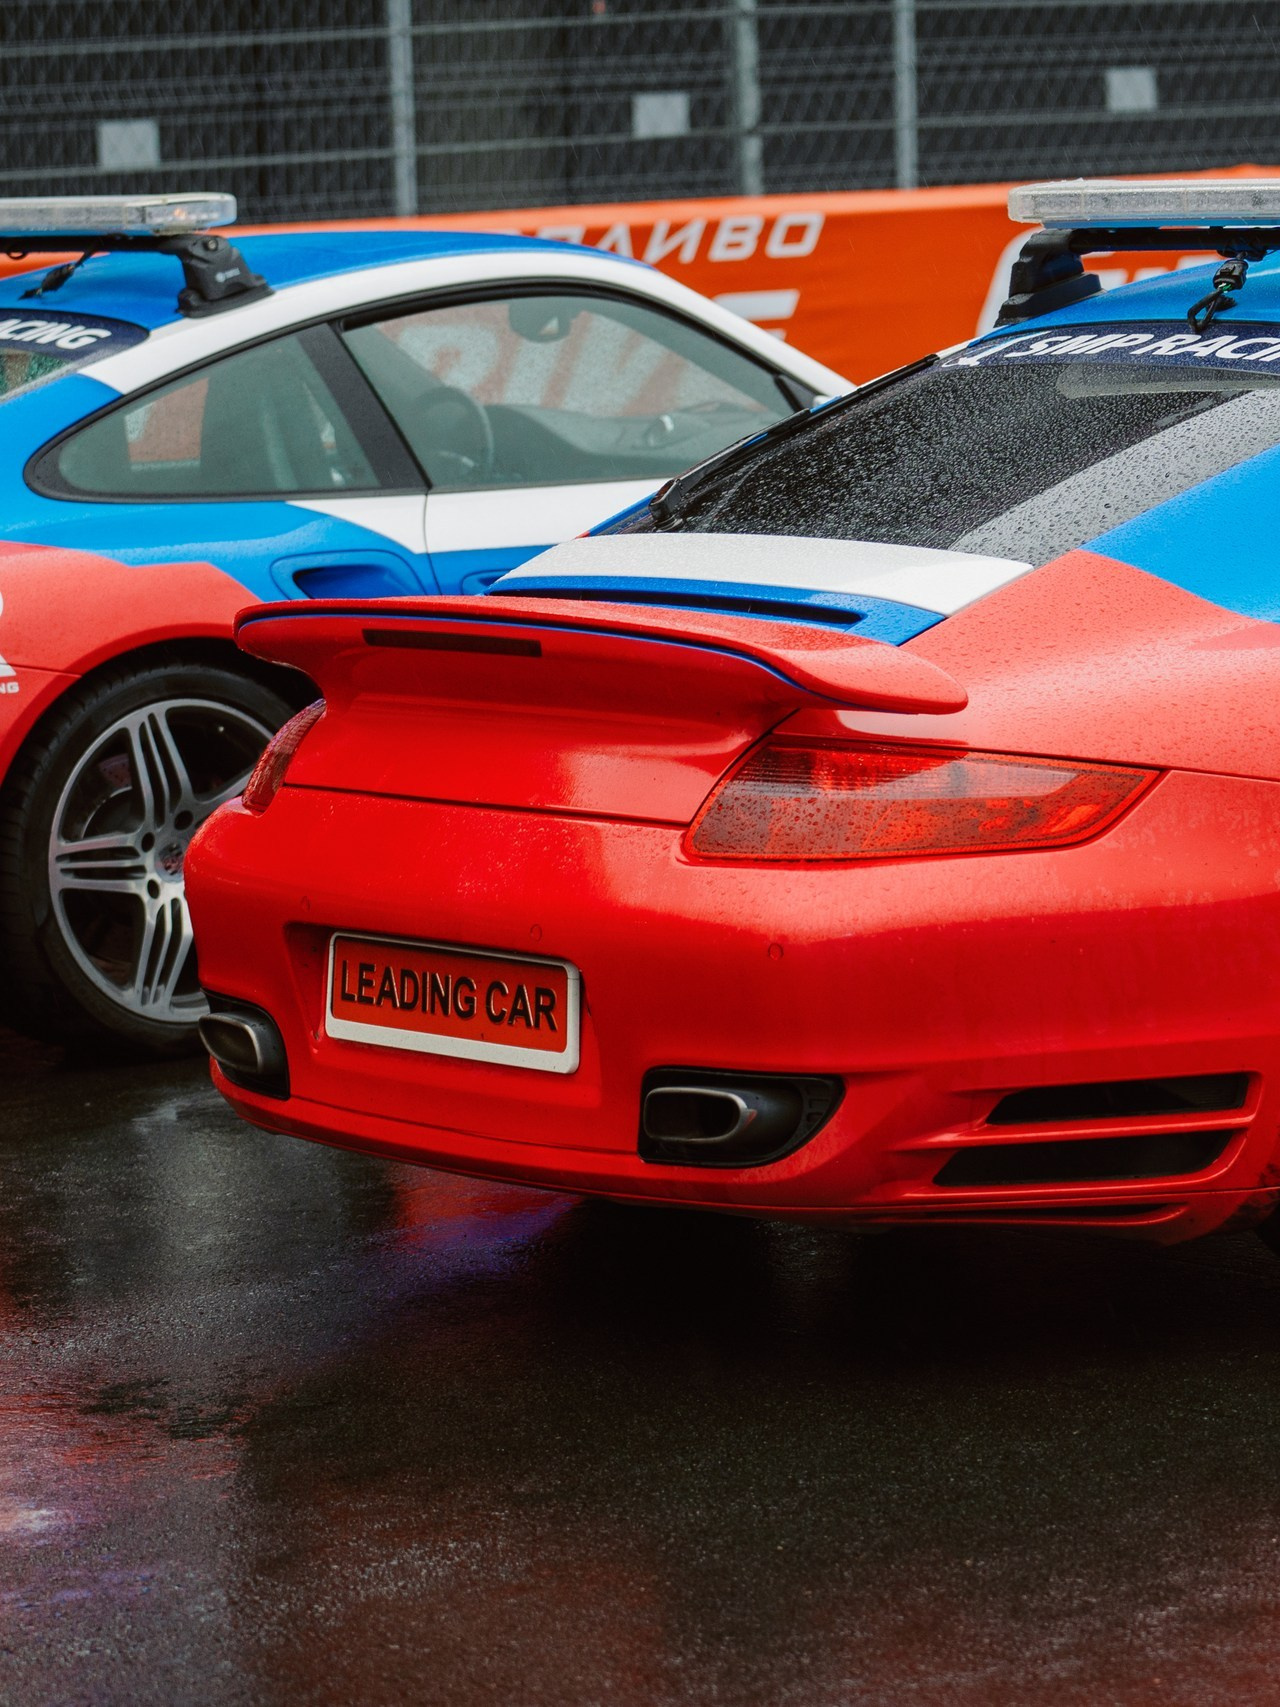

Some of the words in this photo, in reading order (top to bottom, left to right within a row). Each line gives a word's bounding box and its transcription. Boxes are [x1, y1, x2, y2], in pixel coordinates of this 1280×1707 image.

[1003, 333, 1155, 358] SMP
[340, 959, 478, 1019] LEADING
[485, 980, 558, 1031] CAR
